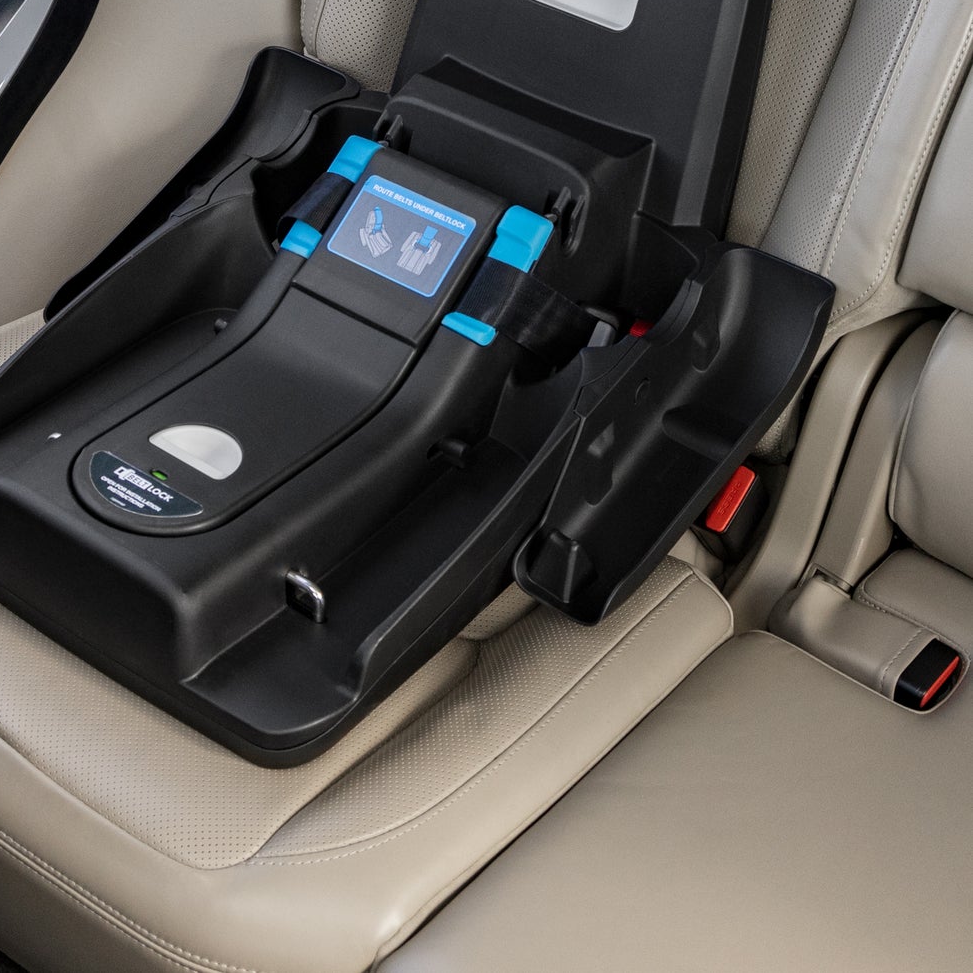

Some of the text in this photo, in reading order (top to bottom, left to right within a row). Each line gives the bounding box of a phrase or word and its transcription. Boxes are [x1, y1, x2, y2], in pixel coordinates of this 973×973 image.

[373, 183, 467, 230] ROUTE BELTS UNDER BELTLOCK
[100, 475, 118, 488] OPEN
[116, 483, 128, 494] FOR
[125, 488, 162, 512] INSTALLATION
[107, 485, 144, 509] INSTRUCTIONS
